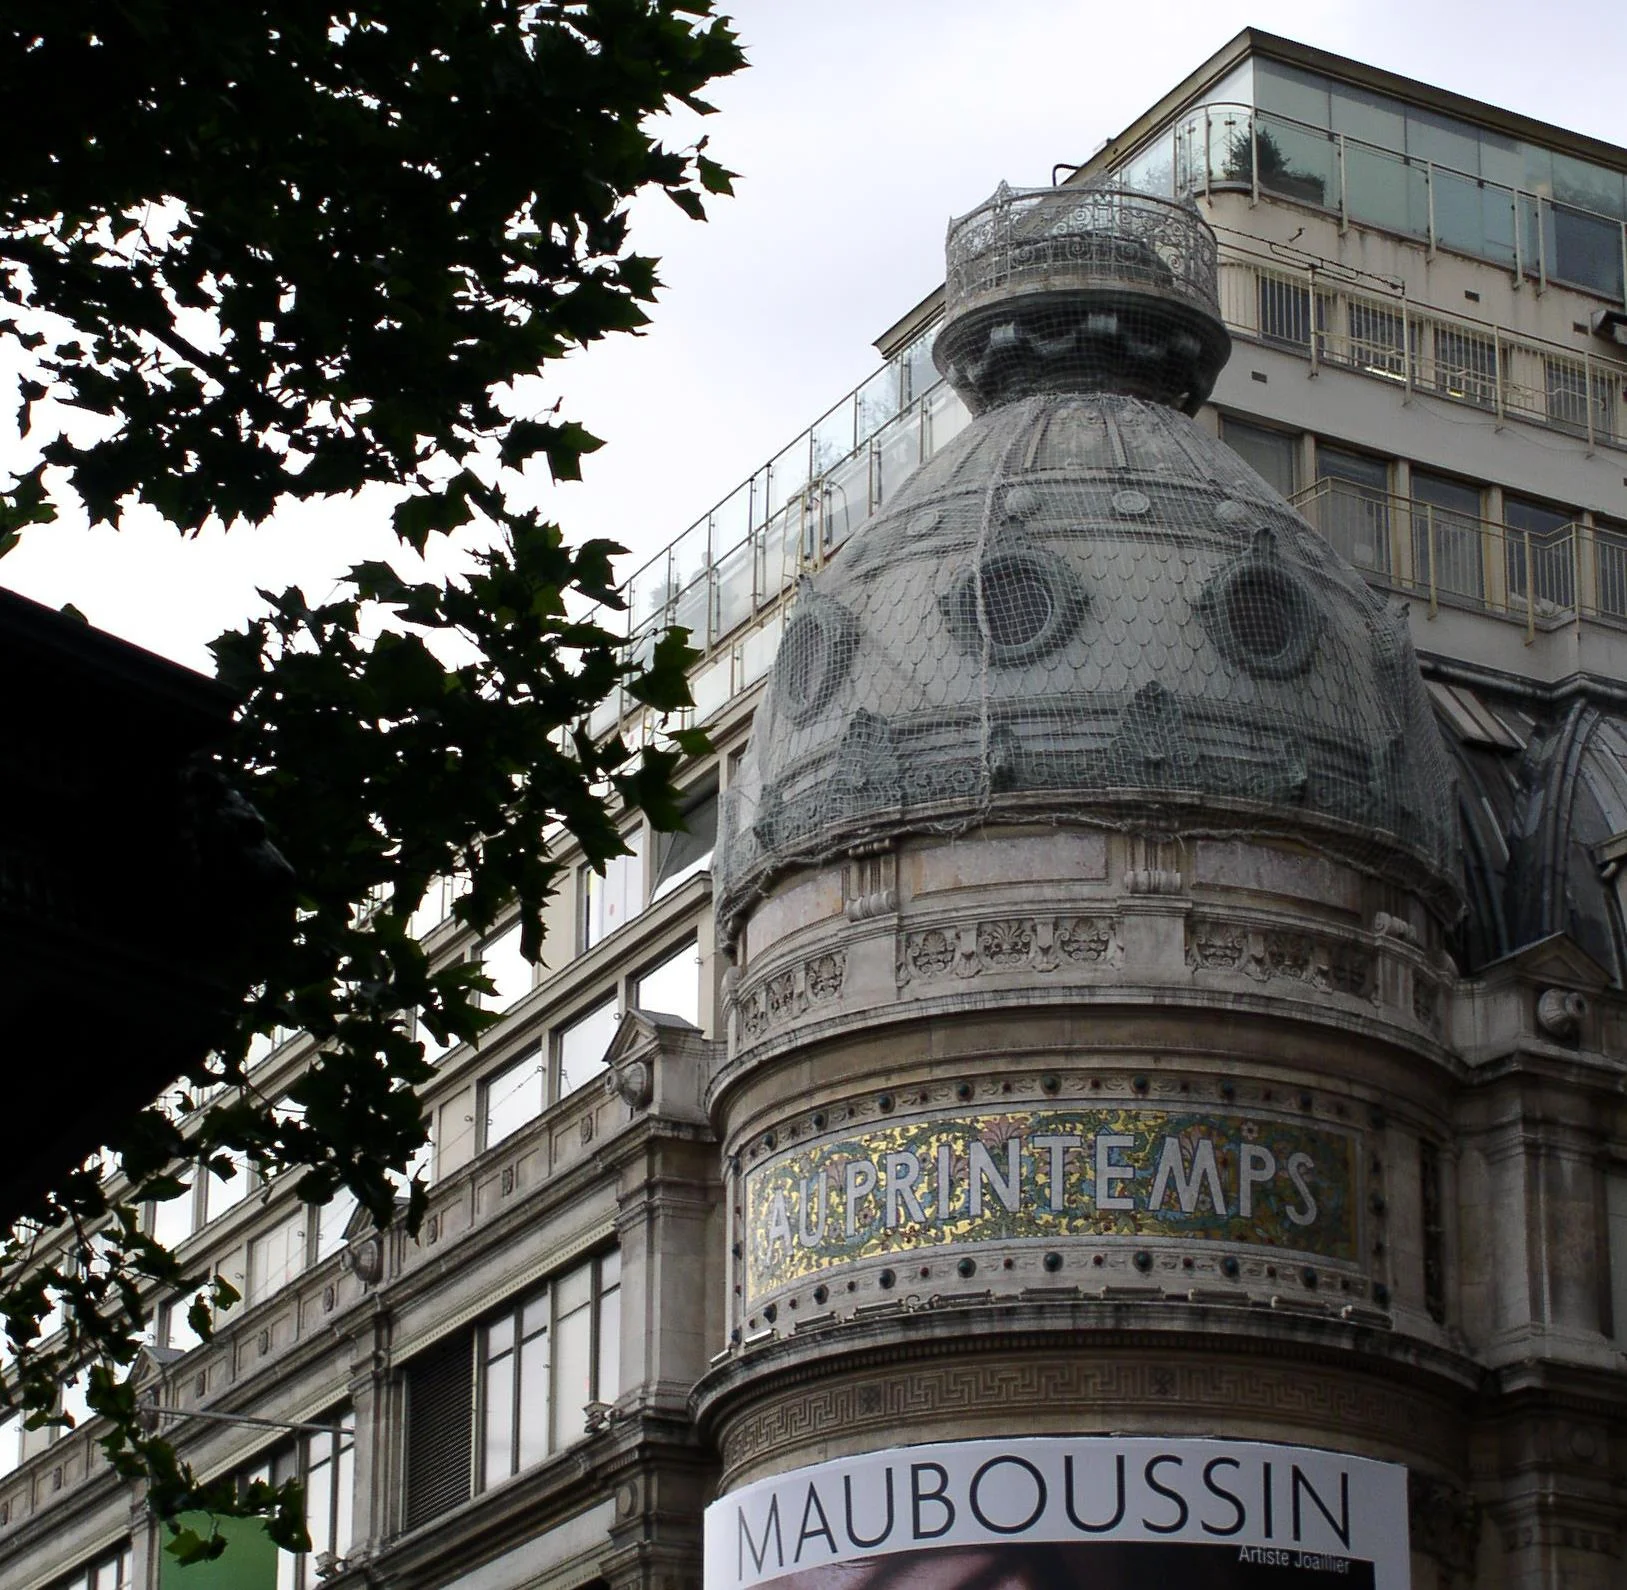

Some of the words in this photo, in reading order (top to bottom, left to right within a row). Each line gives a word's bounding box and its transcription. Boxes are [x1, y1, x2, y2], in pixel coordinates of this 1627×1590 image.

[766, 1171, 827, 1265] AU
[846, 1134, 1317, 1237] PRINTEMPS
[737, 1454, 1350, 1581] MAUBOUSSIN
[1238, 1544, 1289, 1567] Artiste
[1294, 1551, 1349, 1574] Joaillier
